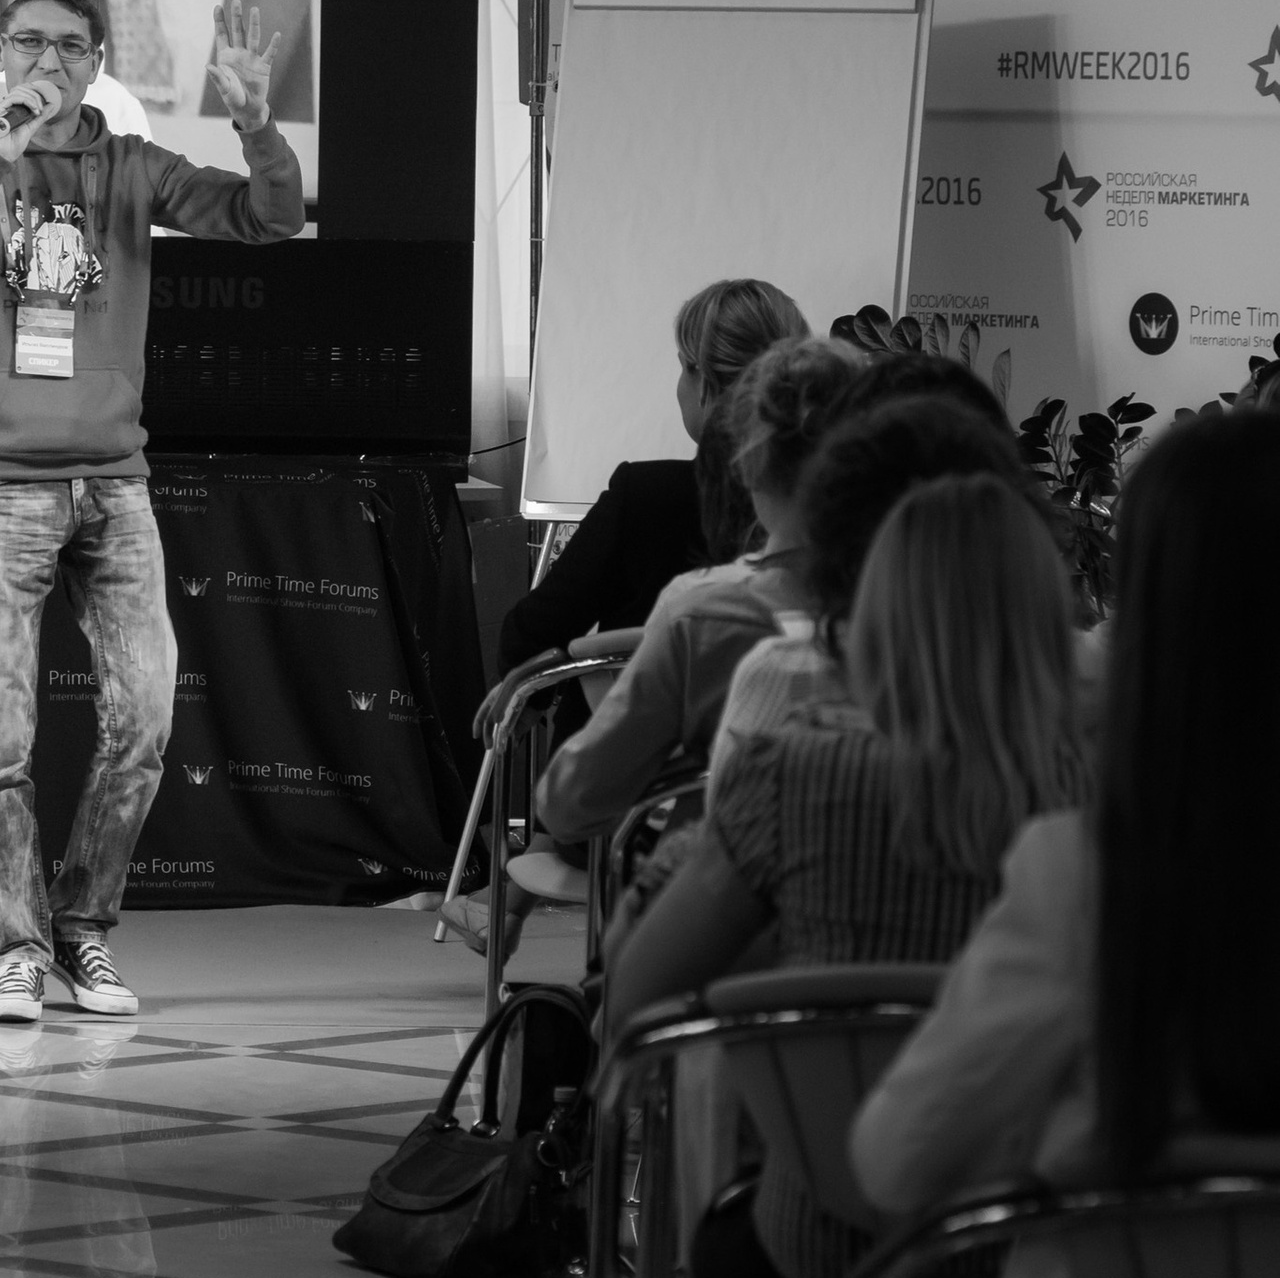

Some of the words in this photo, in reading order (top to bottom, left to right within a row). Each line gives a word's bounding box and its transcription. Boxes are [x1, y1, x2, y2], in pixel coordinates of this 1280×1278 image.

[997, 51, 1190, 80] #RMWEEK2016
[1106, 171, 1197, 187] РОССИЙСКАЯ
[917, 176, 982, 206] 2016
[1106, 190, 1155, 206] НЕДЕЛЯ
[1158, 191, 1250, 207] МАРКЕТИНГА
[1106, 209, 1149, 228] 2016
[151, 277, 265, 309] SUNG
[910, 294, 989, 310] ОССИЙСКАЯ
[951, 313, 1040, 329] МАРКЕТИНГА
[1190, 305, 1241, 326] Prime
[1190, 335, 1251, 347] International
[1253, 336, 1274, 348] Sho
[227, 571, 271, 590] Prime
[275, 575, 315, 594] Time
[320, 579, 379, 601] Forums
[49, 670, 98, 686] Prime
[227, 760, 271, 778] Prime
[275, 763, 313, 780] Time
[317, 766, 372, 788] Forums
[152, 858, 215, 874] Forums
